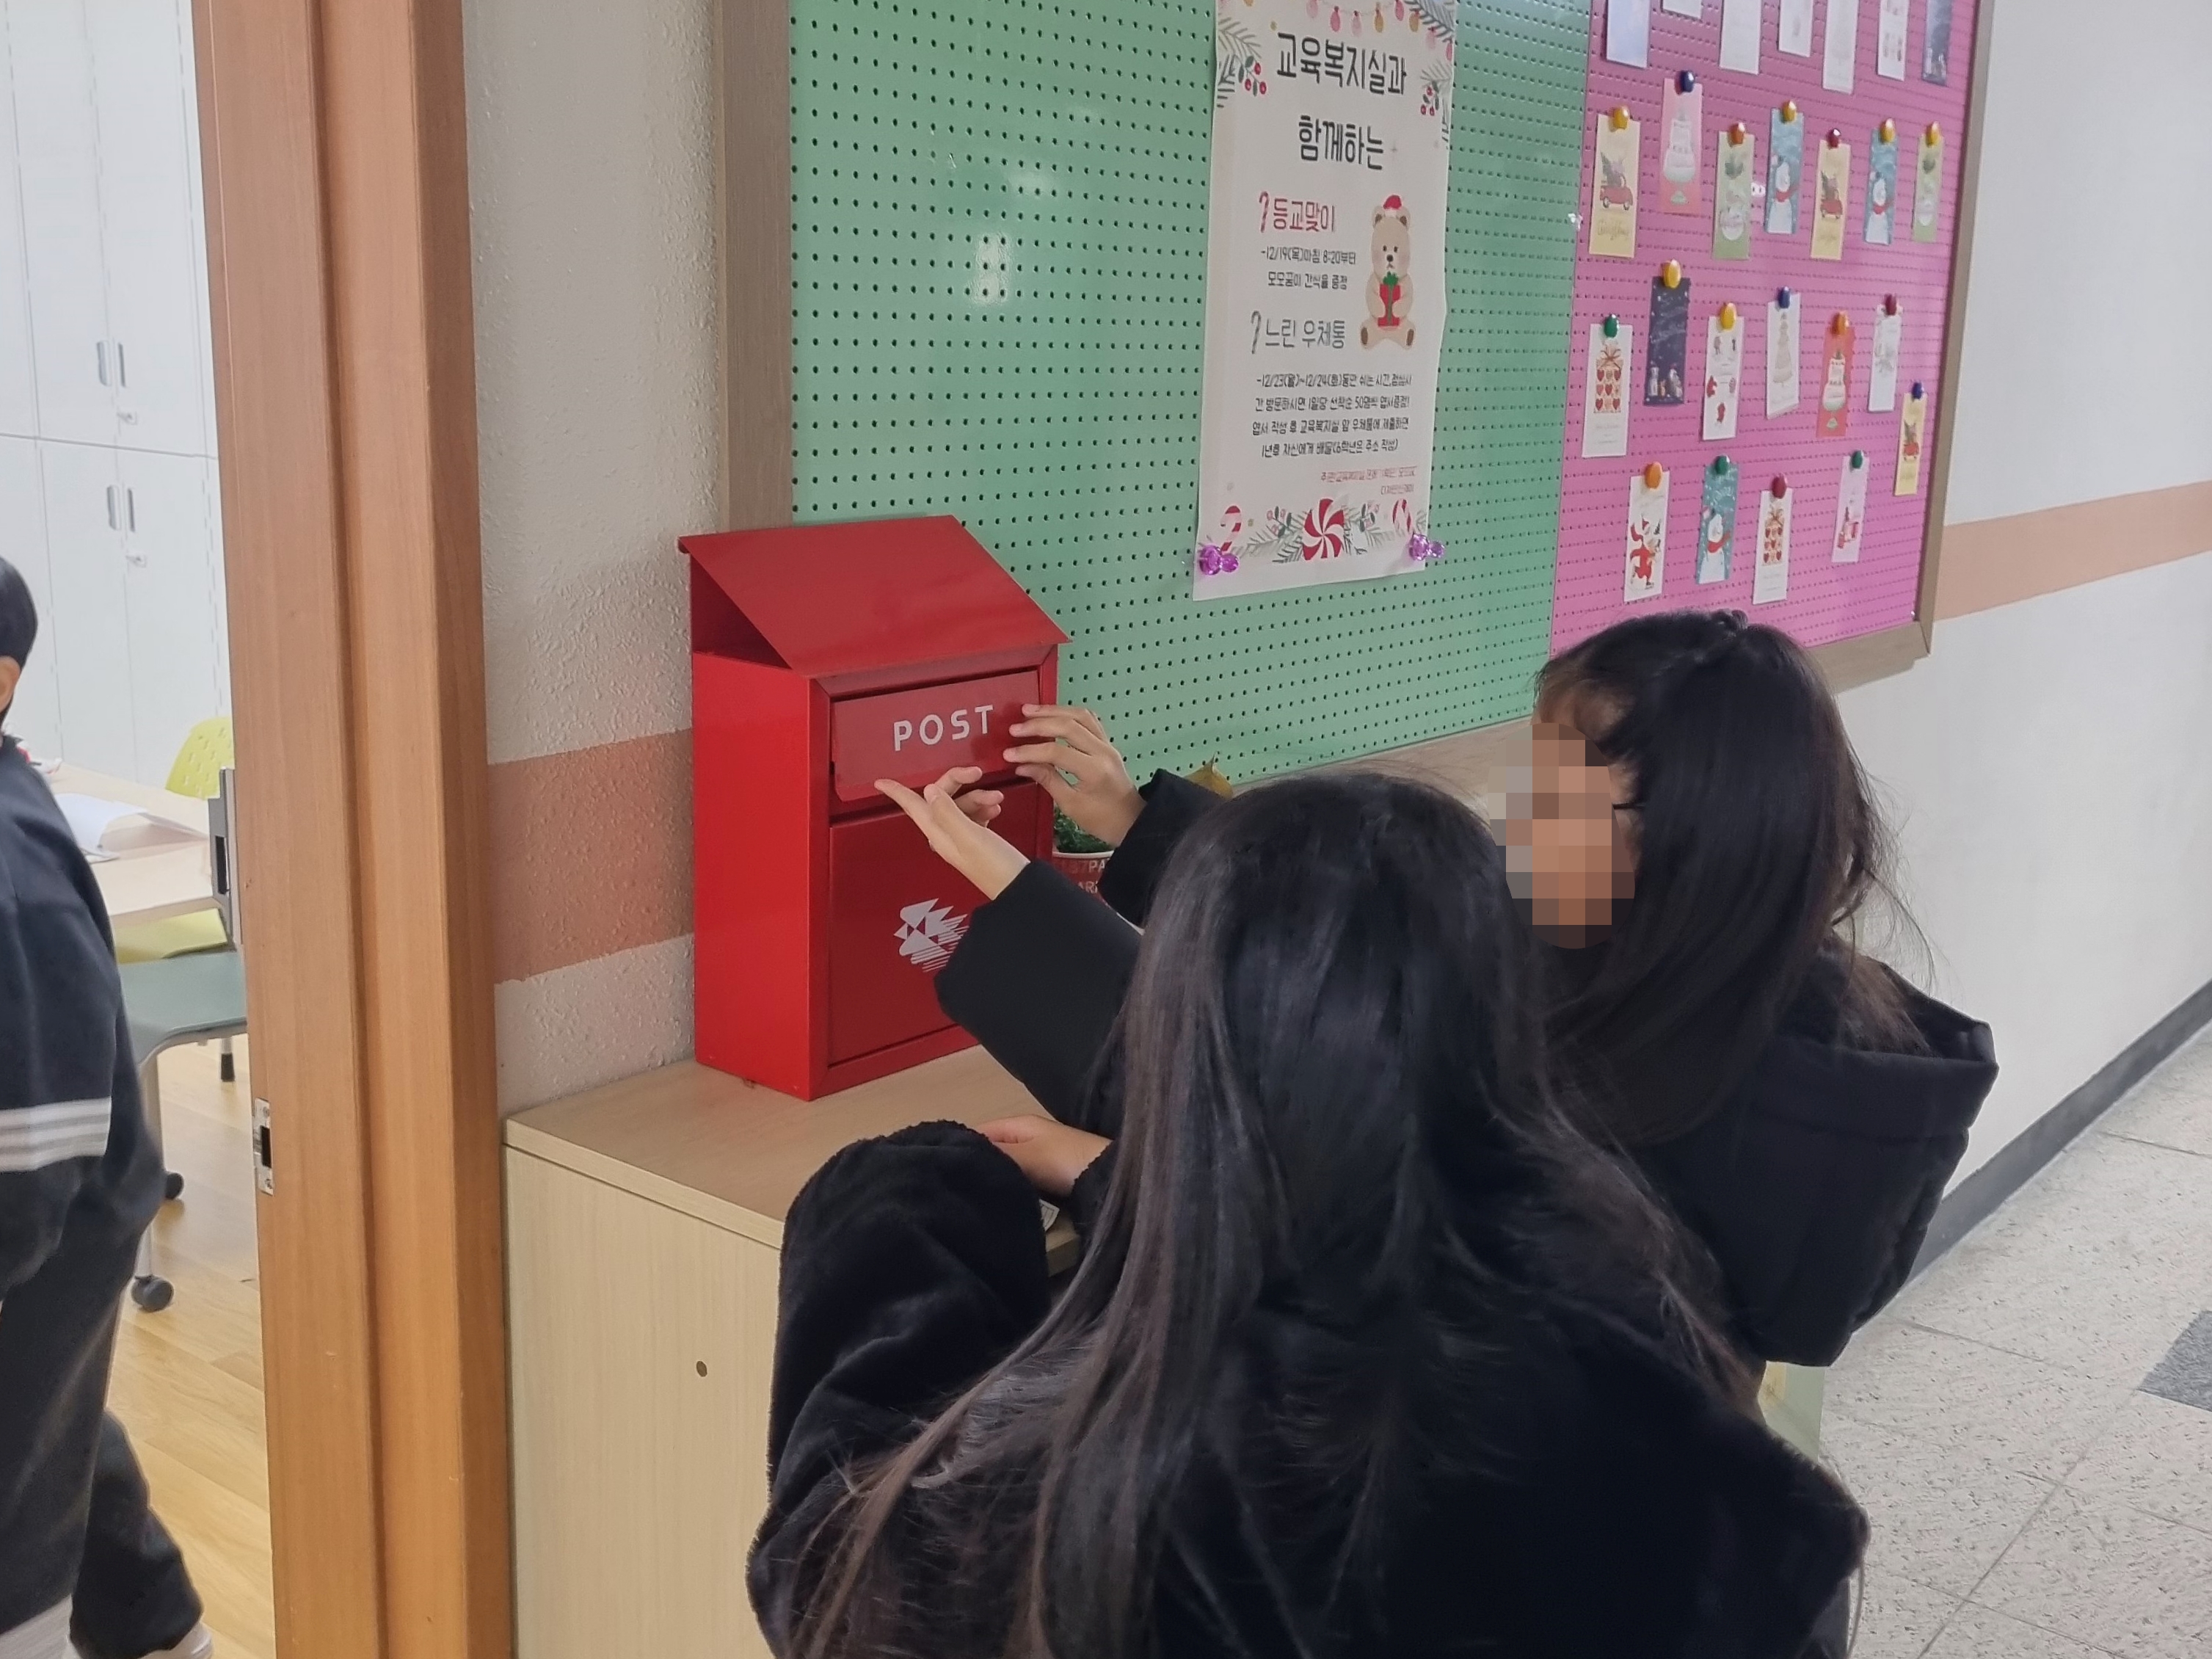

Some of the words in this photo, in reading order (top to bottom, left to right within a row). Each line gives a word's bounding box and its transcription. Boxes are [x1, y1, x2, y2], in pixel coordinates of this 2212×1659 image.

[1276, 32, 1407, 95] 교육복지실과
[1298, 115, 1384, 171] 함께하는
[1273, 197, 1336, 232] 등교맞이
[1304, 273, 1329, 289] 간식을
[1265, 318, 1296, 348] 느린
[1302, 319, 1345, 349] 우체통
[1255, 397, 1264, 412] 간
[1252, 421, 1268, 436] 엽서
[1271, 420, 1287, 435] 작성
[894, 705, 994, 752] POST
